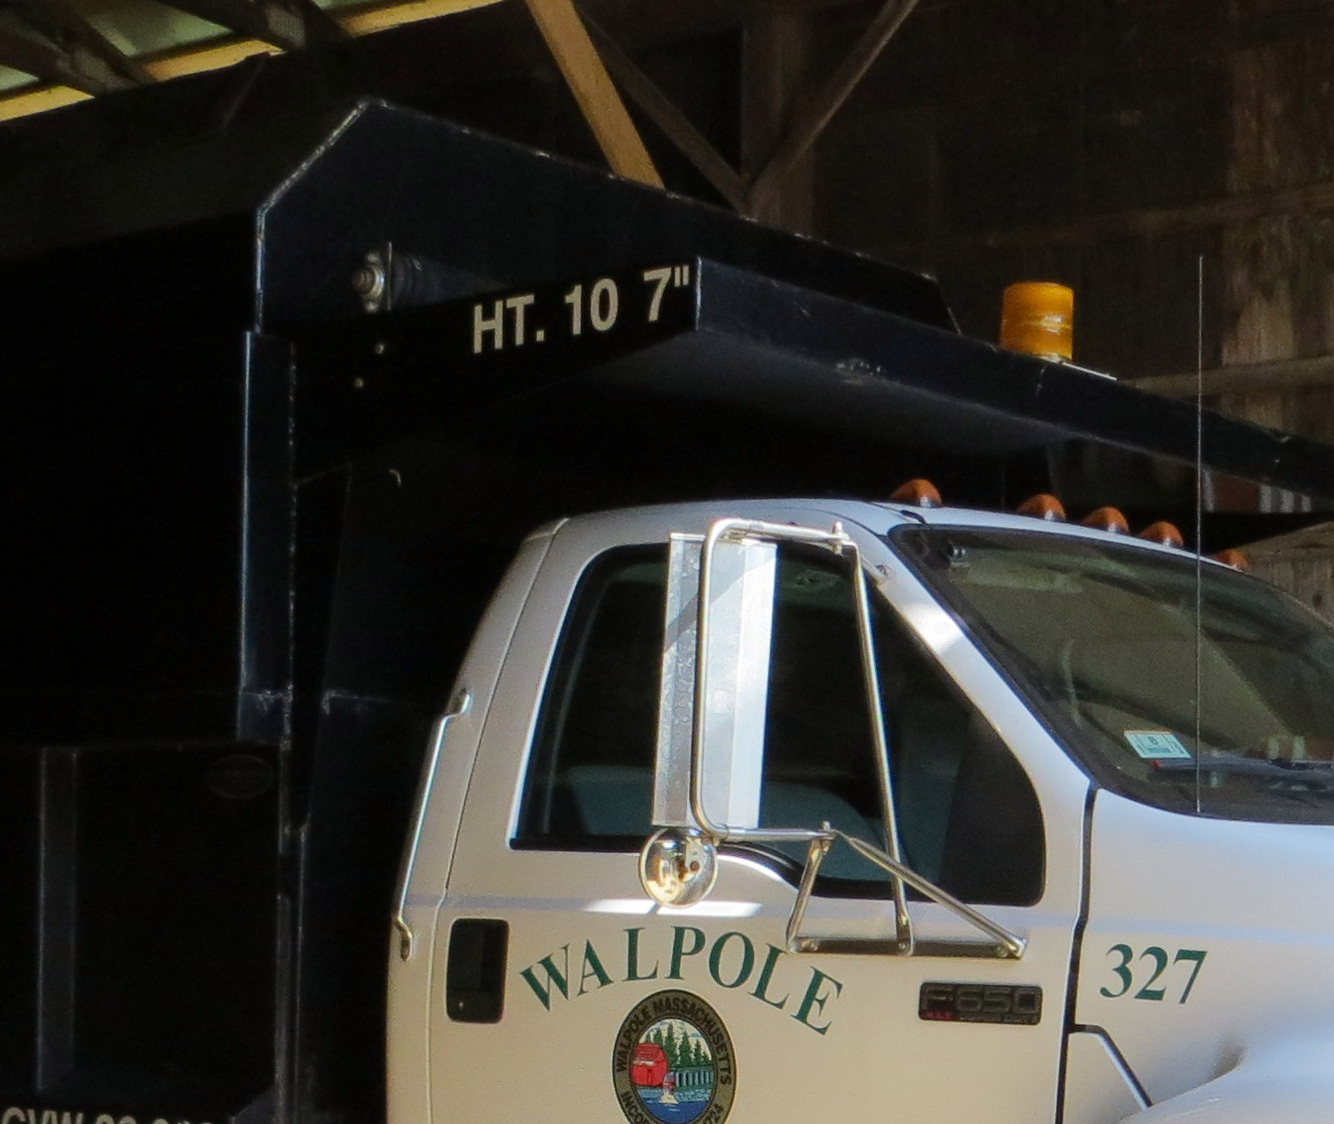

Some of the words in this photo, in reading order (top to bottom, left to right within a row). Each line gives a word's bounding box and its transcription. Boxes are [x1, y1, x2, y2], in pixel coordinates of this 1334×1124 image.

[473, 293, 545, 354] HT.
[565, 277, 619, 336] 10
[643, 264, 690, 323] 7"
[519, 925, 844, 1036] WALPOLE
[1099, 943, 1208, 1005] 327
[617, 1007, 653, 1073] WALPOLE
[653, 998, 732, 1086] MASSACHUSETTS
